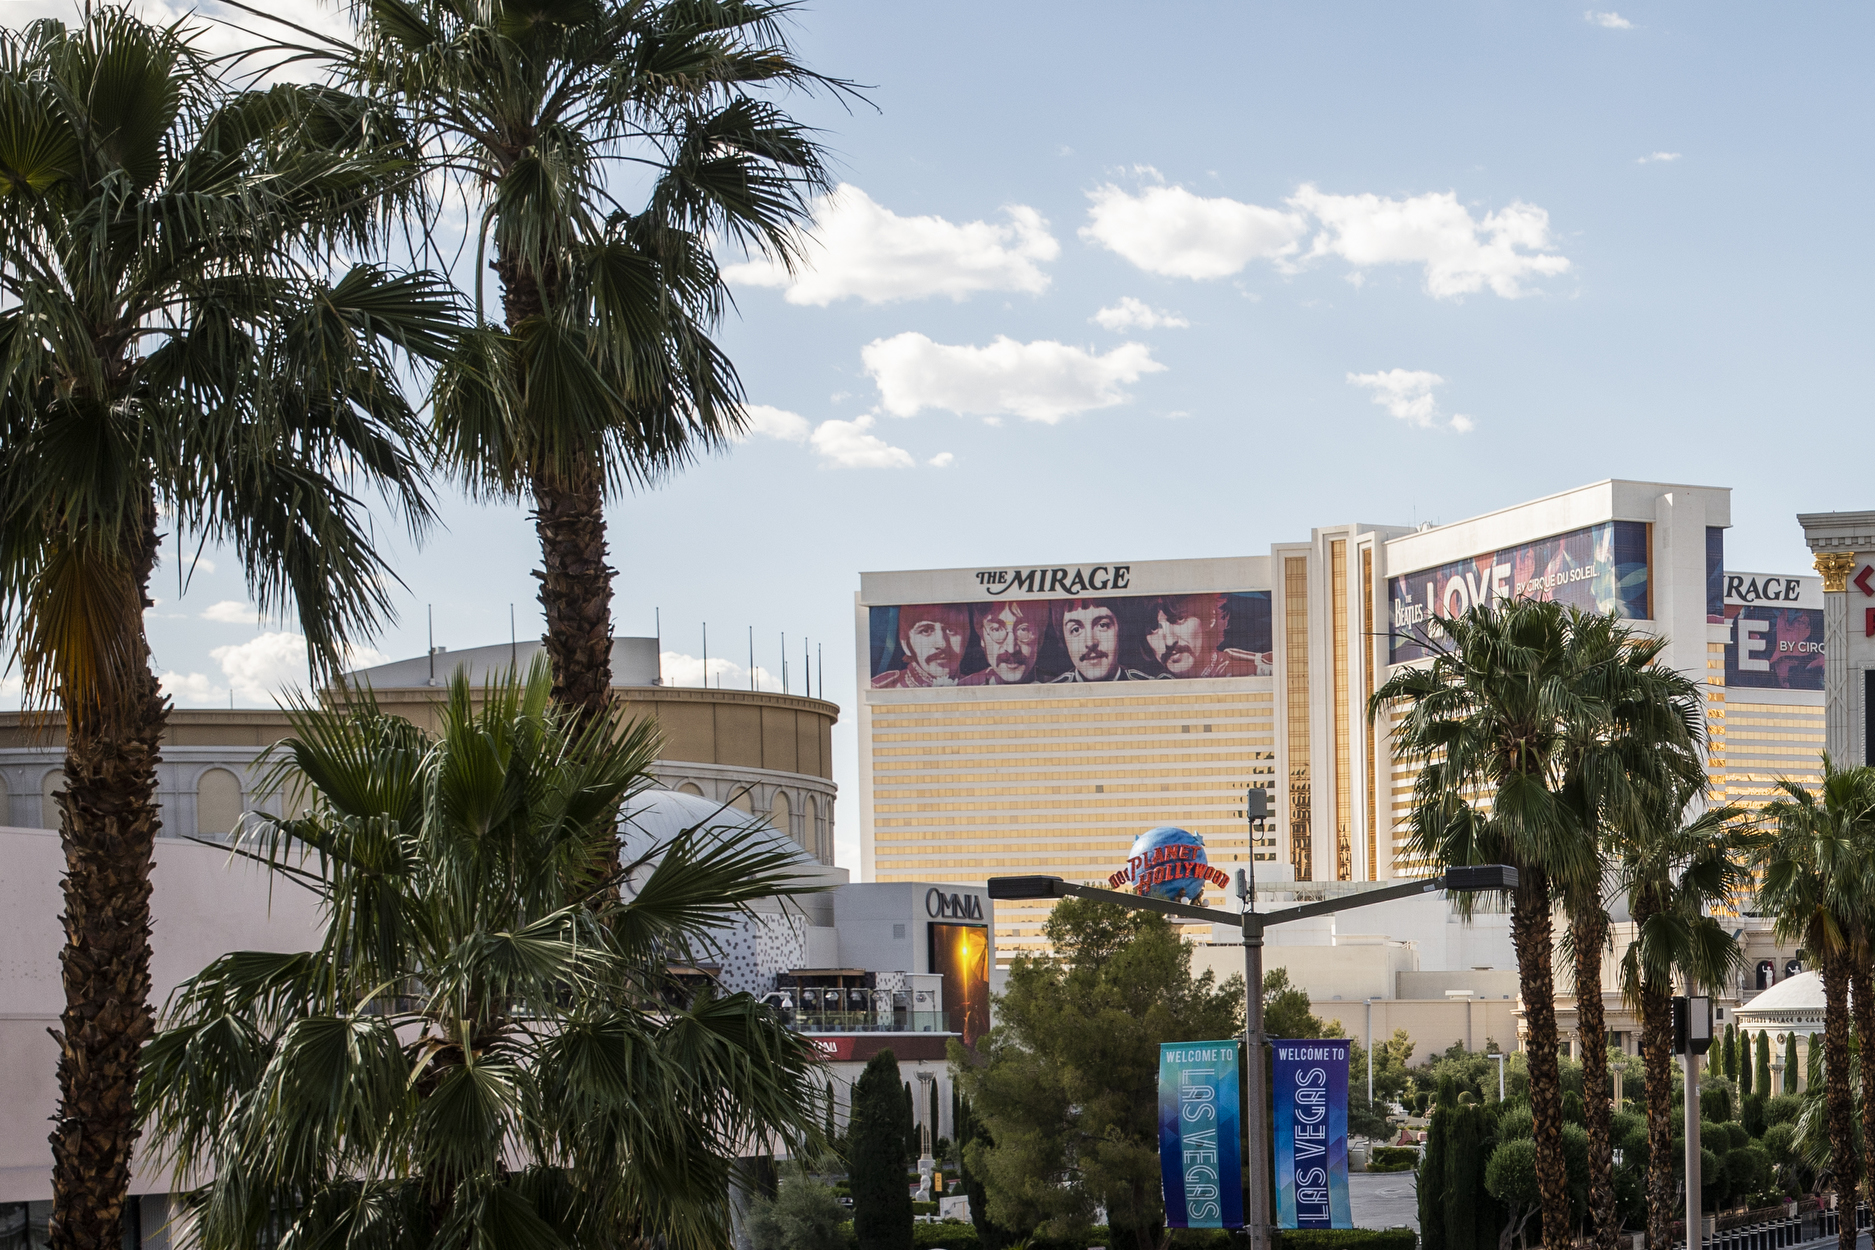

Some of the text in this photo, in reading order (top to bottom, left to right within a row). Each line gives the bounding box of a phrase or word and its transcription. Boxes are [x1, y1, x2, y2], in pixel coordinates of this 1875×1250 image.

[976, 566, 1130, 595] THE MIRAGE
[1528, 575, 1556, 592] CIRQUE
[1557, 571, 1569, 584] DU
[1723, 575, 1800, 602] RAGE
[1395, 598, 1423, 629] BEATLES
[1780, 641, 1798, 651] BY
[1127, 844, 1201, 882] PLANET
[1133, 862, 1230, 896] HOLLYWOOD
[926, 887, 984, 920] OMNIA
[1166, 1049, 1233, 1063] WELCOME TO
[1279, 1048, 1344, 1060] WELCOME TO
[1182, 1068, 1220, 1220] LAS VEGAS
[1295, 1067, 1330, 1221] LAS VEGAS
